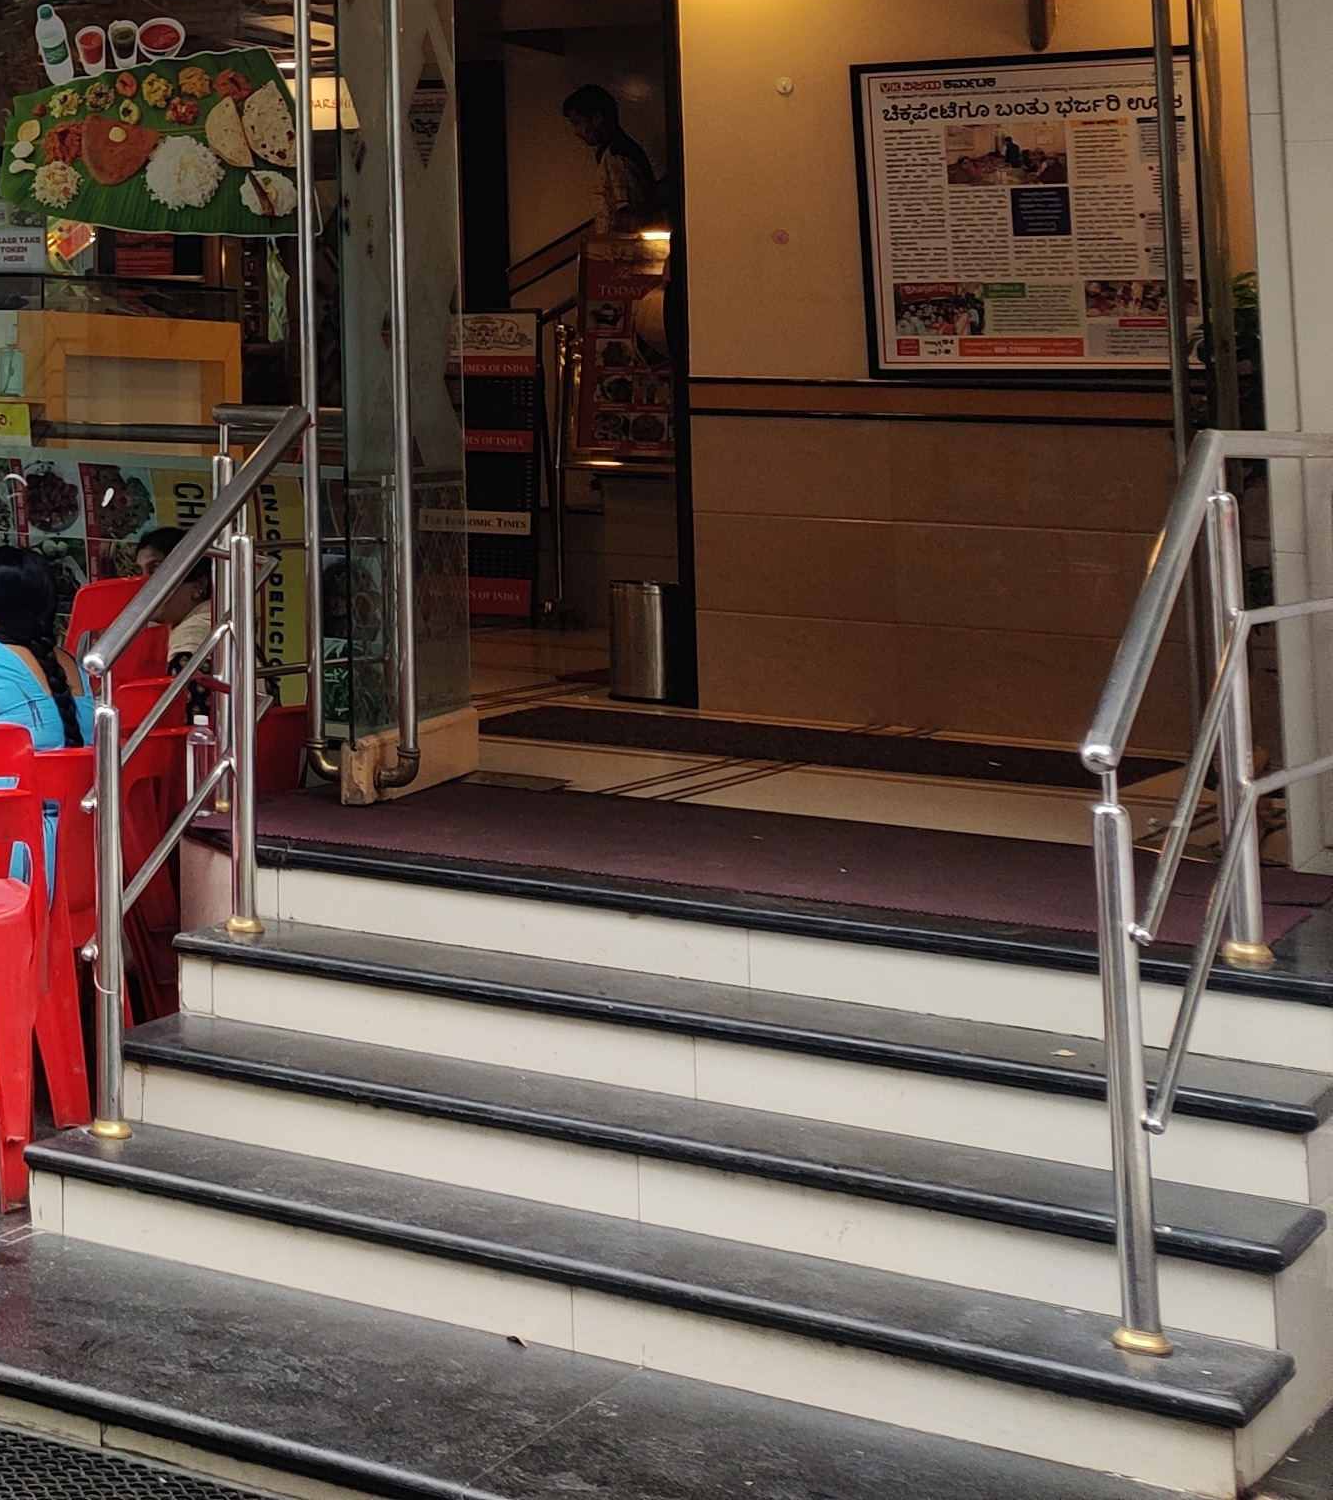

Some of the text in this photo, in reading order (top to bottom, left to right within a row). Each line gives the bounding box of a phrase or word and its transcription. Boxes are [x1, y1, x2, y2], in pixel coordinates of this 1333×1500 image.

[882, 94, 1121, 127] ಚಿಕ್ಕಪೇಟೆಗೂ ಬಂತು ಭರ್ಜರಿ
[18, 236, 41, 244] TAKE
[0, 245, 28, 254] TOKEN
[3, 254, 25, 262] HERE
[487, 362, 530, 374] OF INDIA
[480, 436, 494, 447] OF
[495, 437, 524, 448] INDIA
[496, 516, 527, 530] TIMES
[478, 590, 521, 603] OF INDIA
